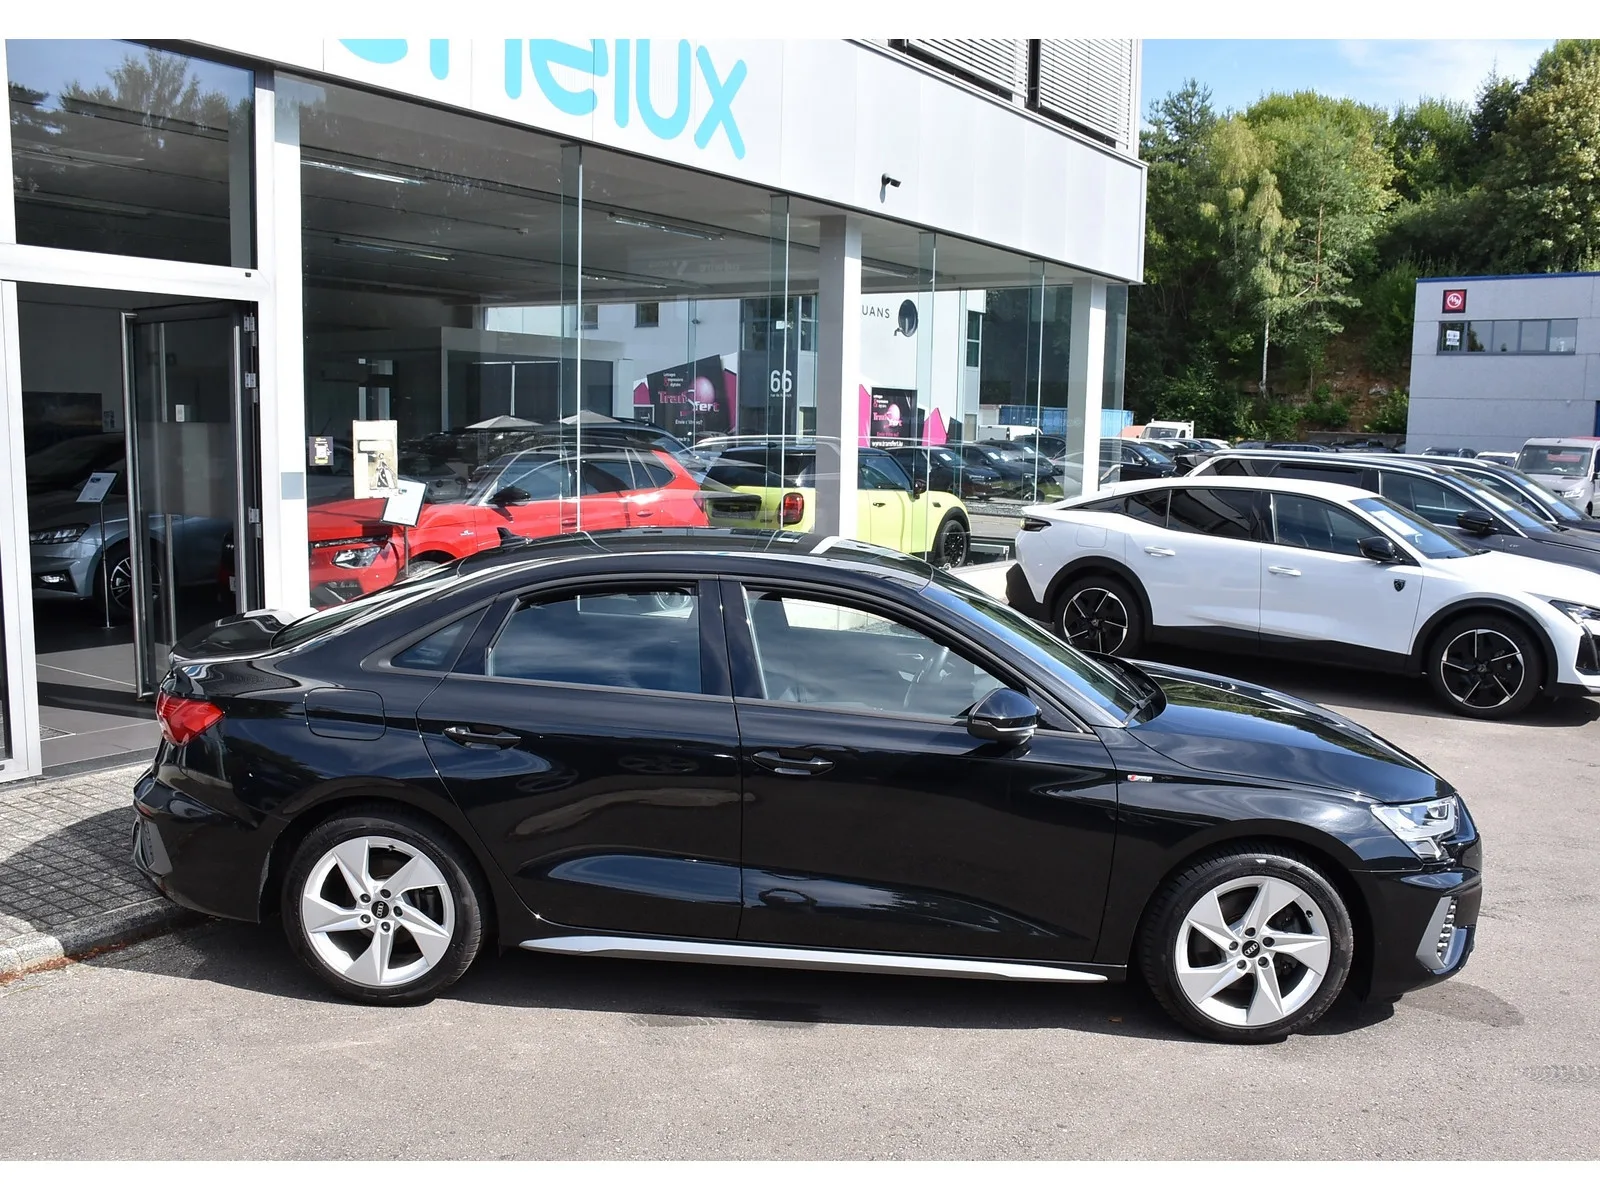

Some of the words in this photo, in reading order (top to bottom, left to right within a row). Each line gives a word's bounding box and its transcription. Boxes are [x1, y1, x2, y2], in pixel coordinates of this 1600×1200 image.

[338, 39, 747, 160] elux
[862, 304, 890, 319] UANS
[770, 369, 793, 393] 66
